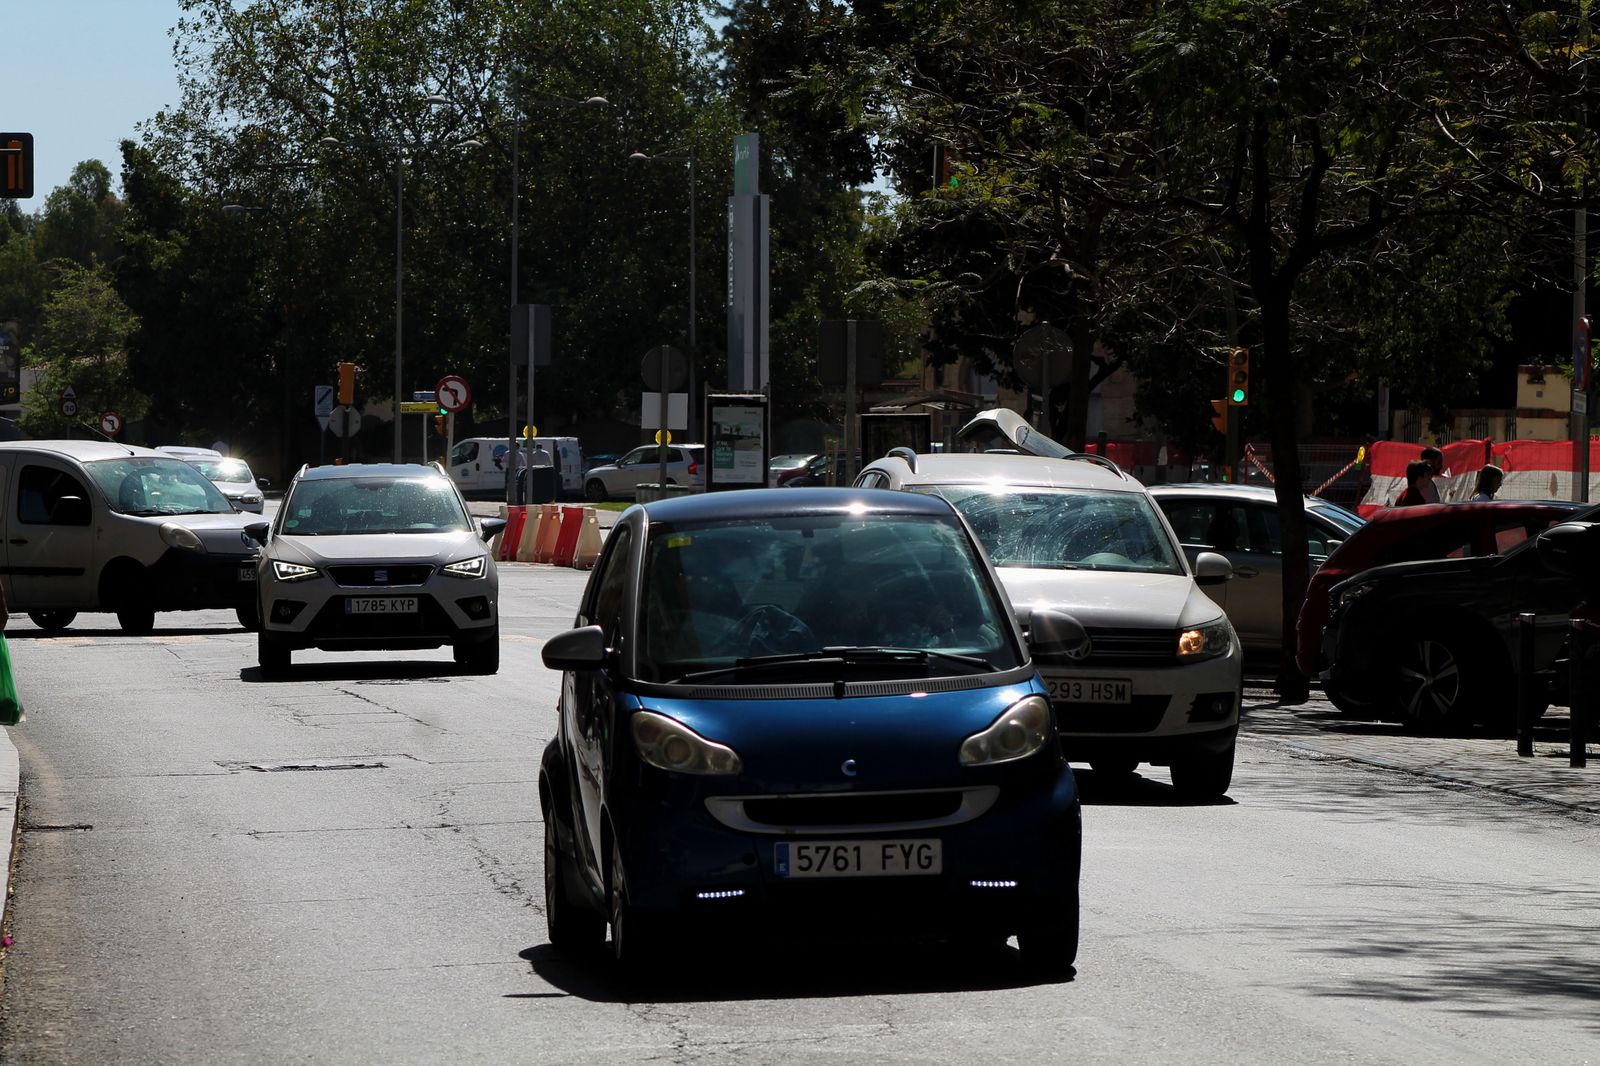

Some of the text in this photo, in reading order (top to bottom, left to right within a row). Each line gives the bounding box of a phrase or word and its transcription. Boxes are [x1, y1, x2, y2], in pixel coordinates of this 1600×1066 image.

[356, 599, 415, 612] 1785 KYP
[1091, 683, 1126, 701] HSM
[797, 843, 933, 872] 5761 FYG
